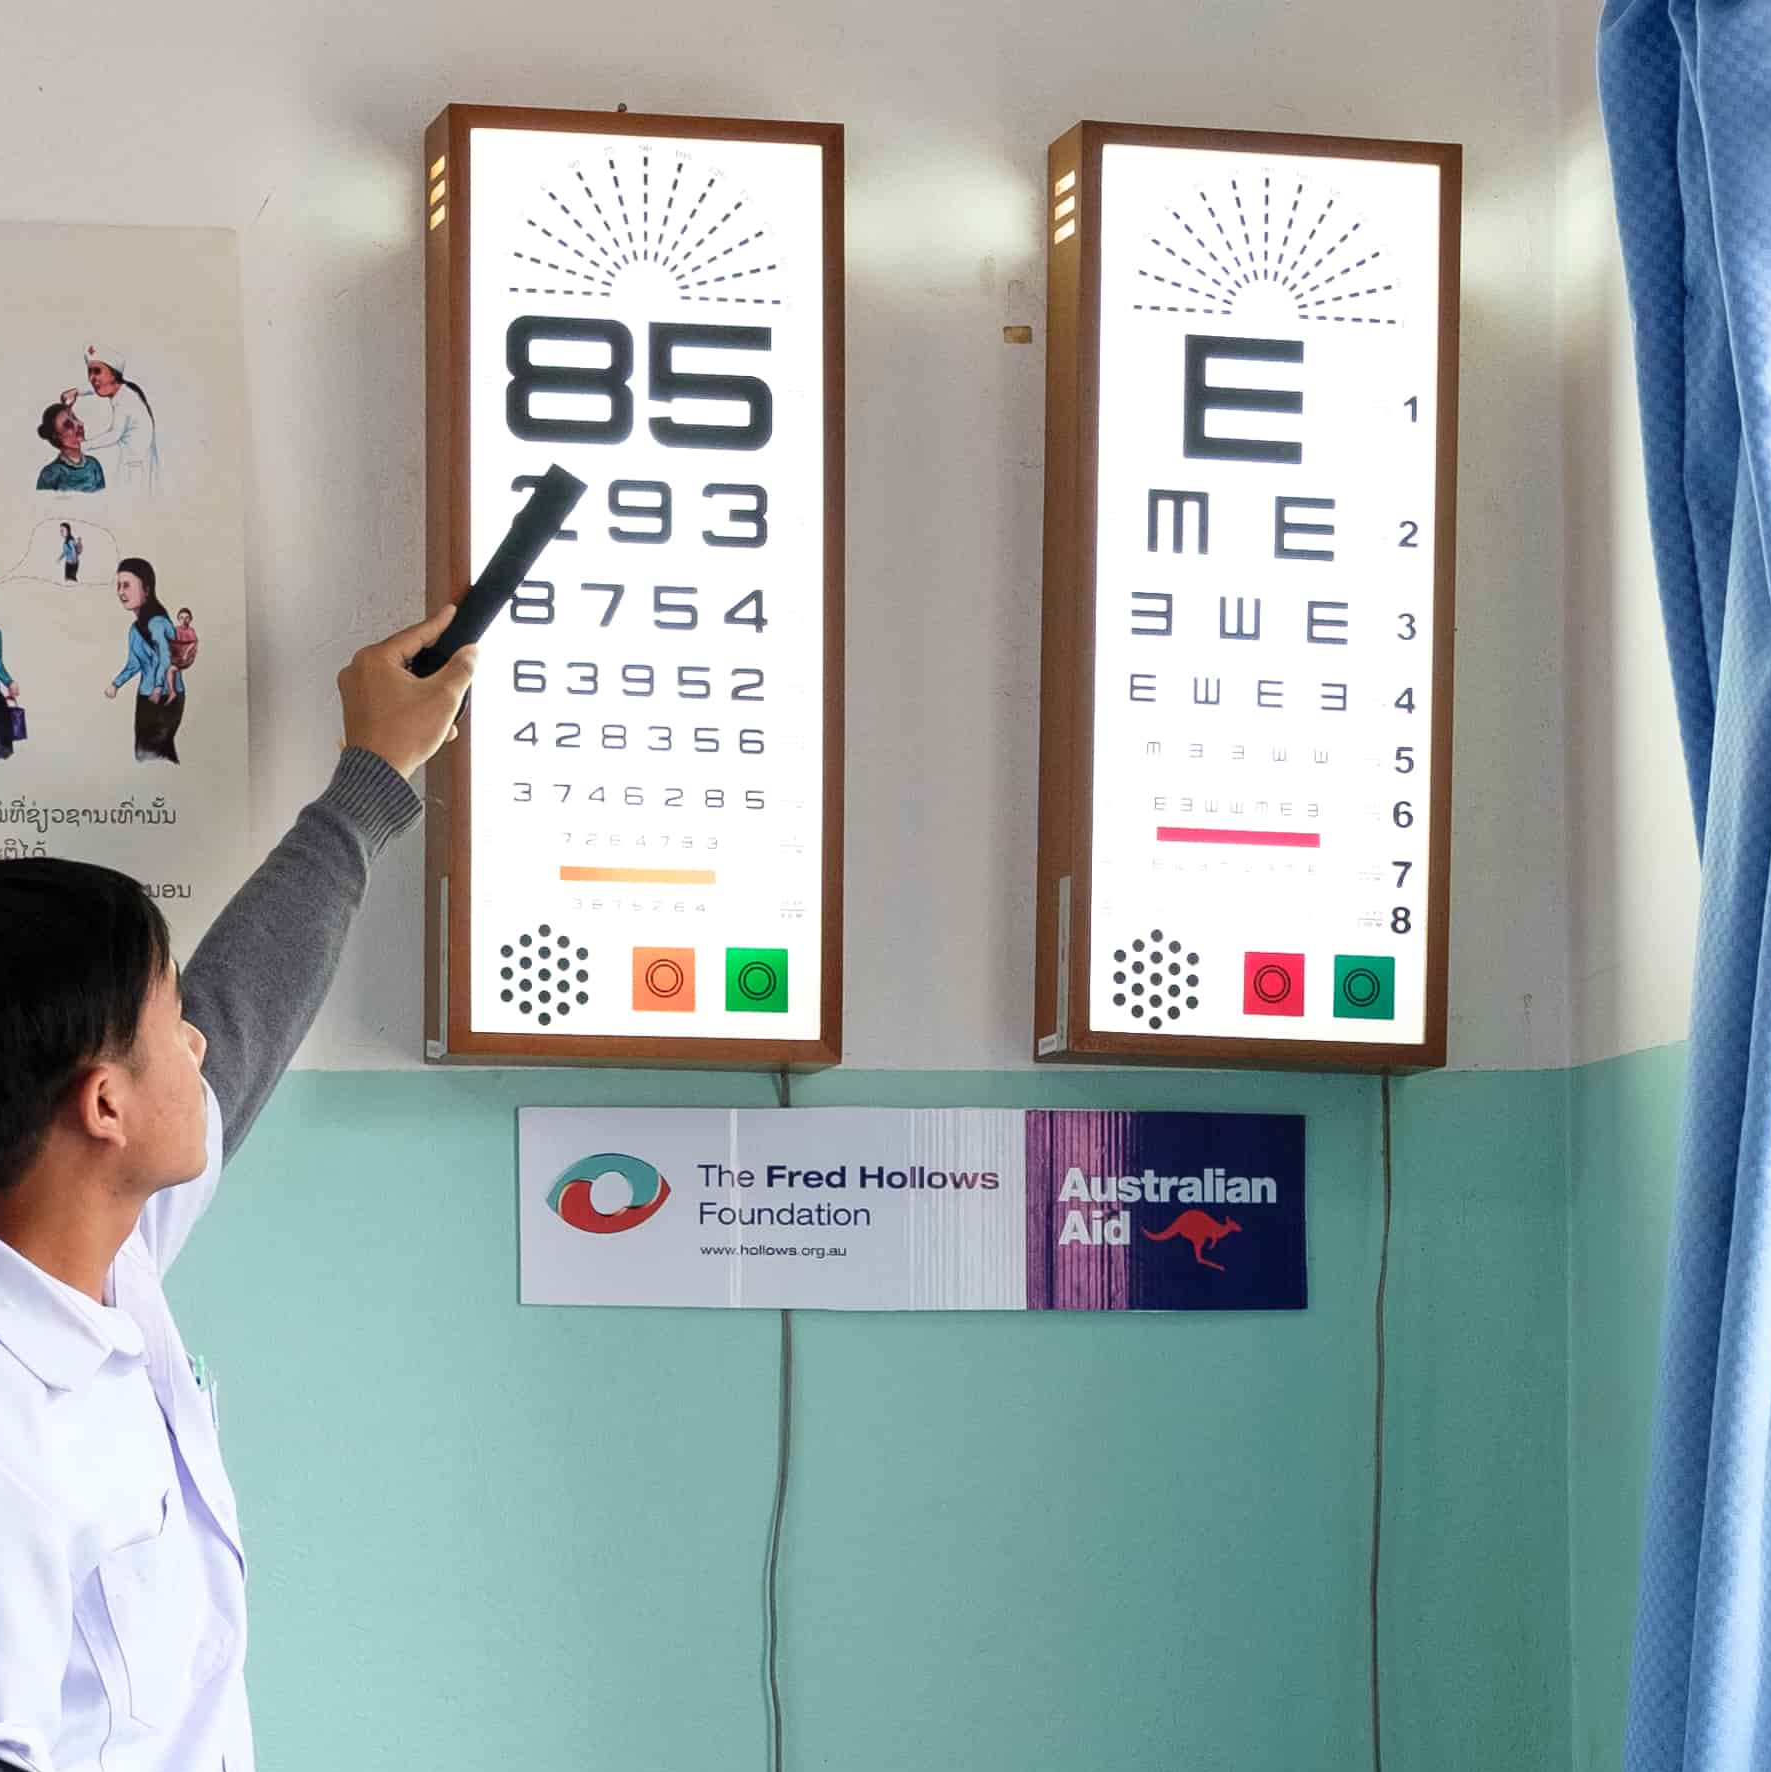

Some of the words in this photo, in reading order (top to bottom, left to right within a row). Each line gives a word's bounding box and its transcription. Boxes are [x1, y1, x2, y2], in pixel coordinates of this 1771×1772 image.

[506, 316, 773, 451] 85
[1184, 334, 1305, 465] E
[1403, 395, 1418, 423] 1
[1274, 495, 1335, 562] E
[1398, 520, 1419, 548] 2
[1306, 600, 1349, 646] E
[1397, 612, 1417, 641] 3
[1129, 673, 1157, 703] E
[1256, 679, 1284, 709] E
[1393, 687, 1416, 715] 4
[1394, 746, 1415, 774] 5
[1392, 800, 1414, 829] 6
[1391, 860, 1413, 889] 7
[1390, 906, 1412, 935] 8
[697, 1164, 755, 1188] The
[766, 1164, 848, 1189] Fred
[859, 1166, 1000, 1190] Hollows
[1058, 1167, 1278, 1204] Australian
[698, 1202, 871, 1226] Foundation
[1058, 1210, 1132, 1246] Aid
[700, 1244, 848, 1259] www.hollows.org.au
